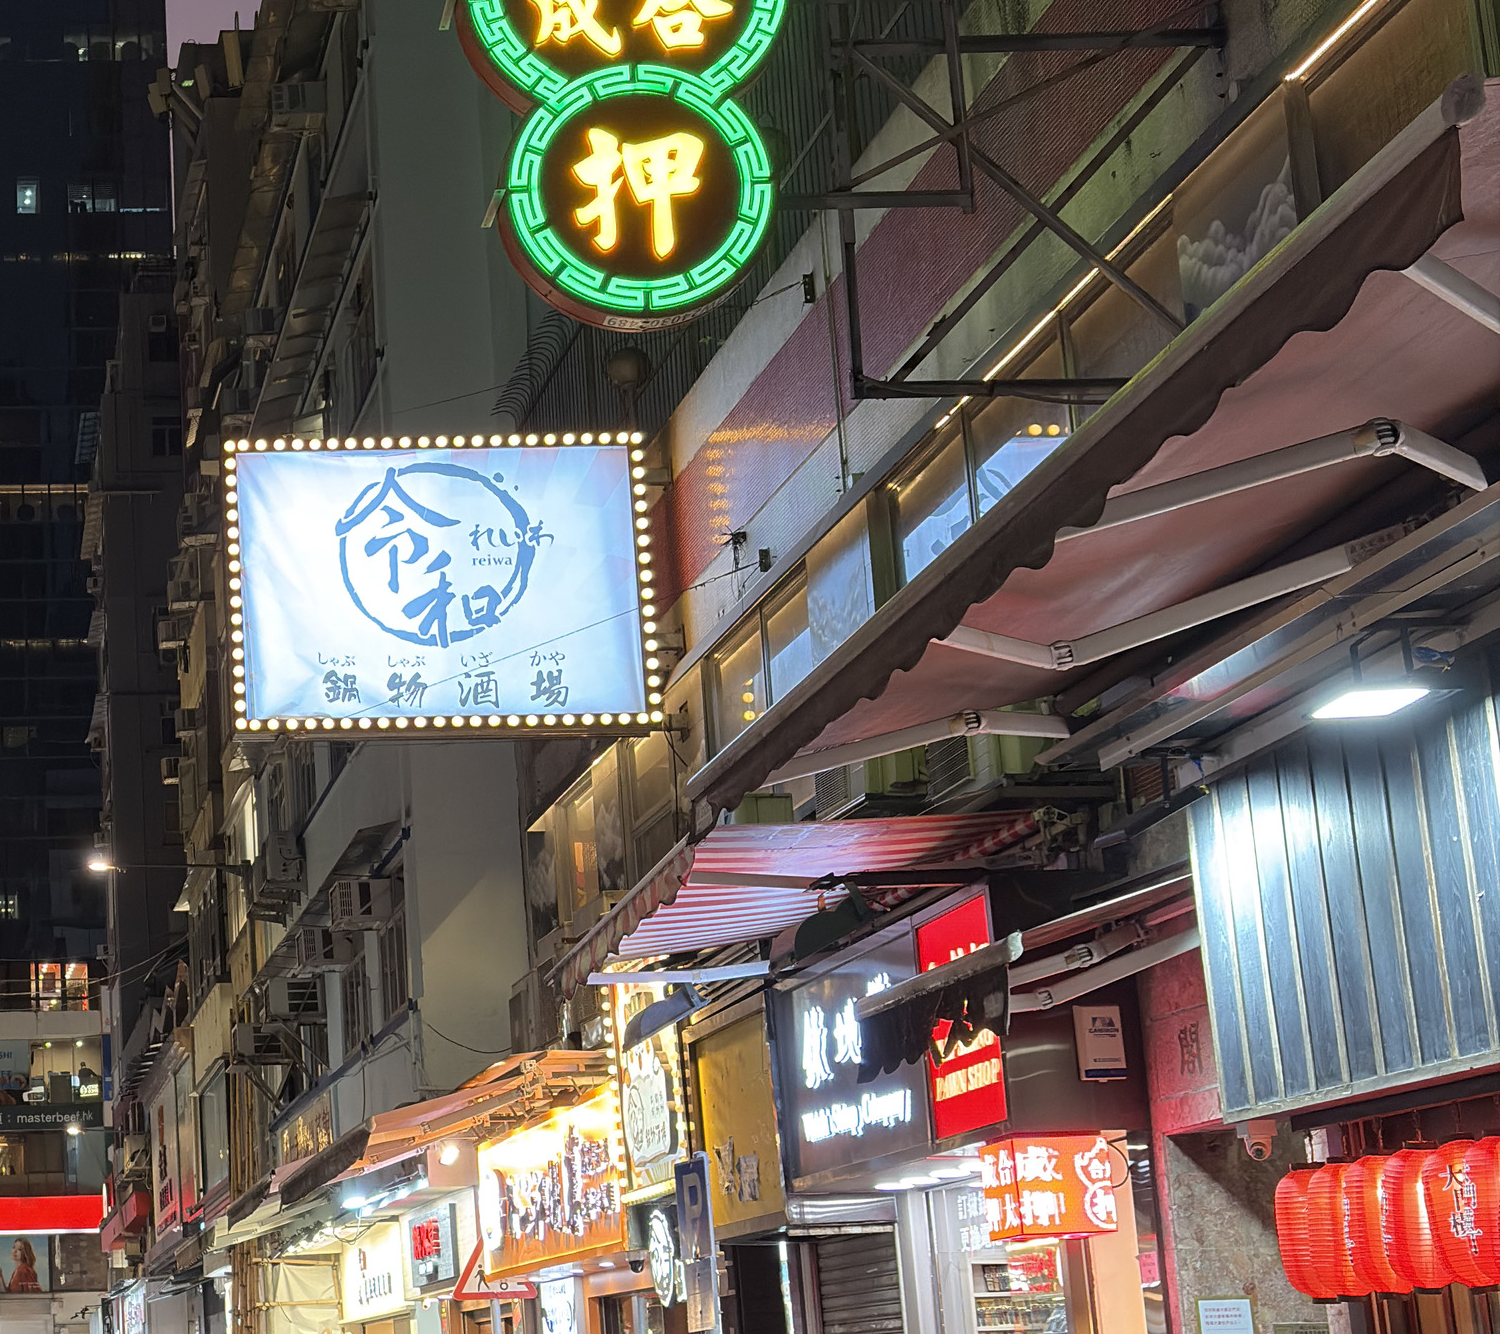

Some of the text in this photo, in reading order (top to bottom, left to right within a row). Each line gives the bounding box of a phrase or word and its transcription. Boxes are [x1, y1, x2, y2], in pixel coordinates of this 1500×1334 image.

[571, 126, 708, 262] 押
[469, 520, 555, 551] れいわ
[336, 467, 501, 648] 令和
[472, 555, 513, 567] reiwa
[318, 650, 566, 668] しゃぶ しゃぶ いざ かや
[322, 668, 570, 709] 鍋物酒場
[935, 1058, 1000, 1102] PAWN SHOP
[16, 1109, 94, 1125] masterbeef.hk
[682, 1170, 703, 1247] P
